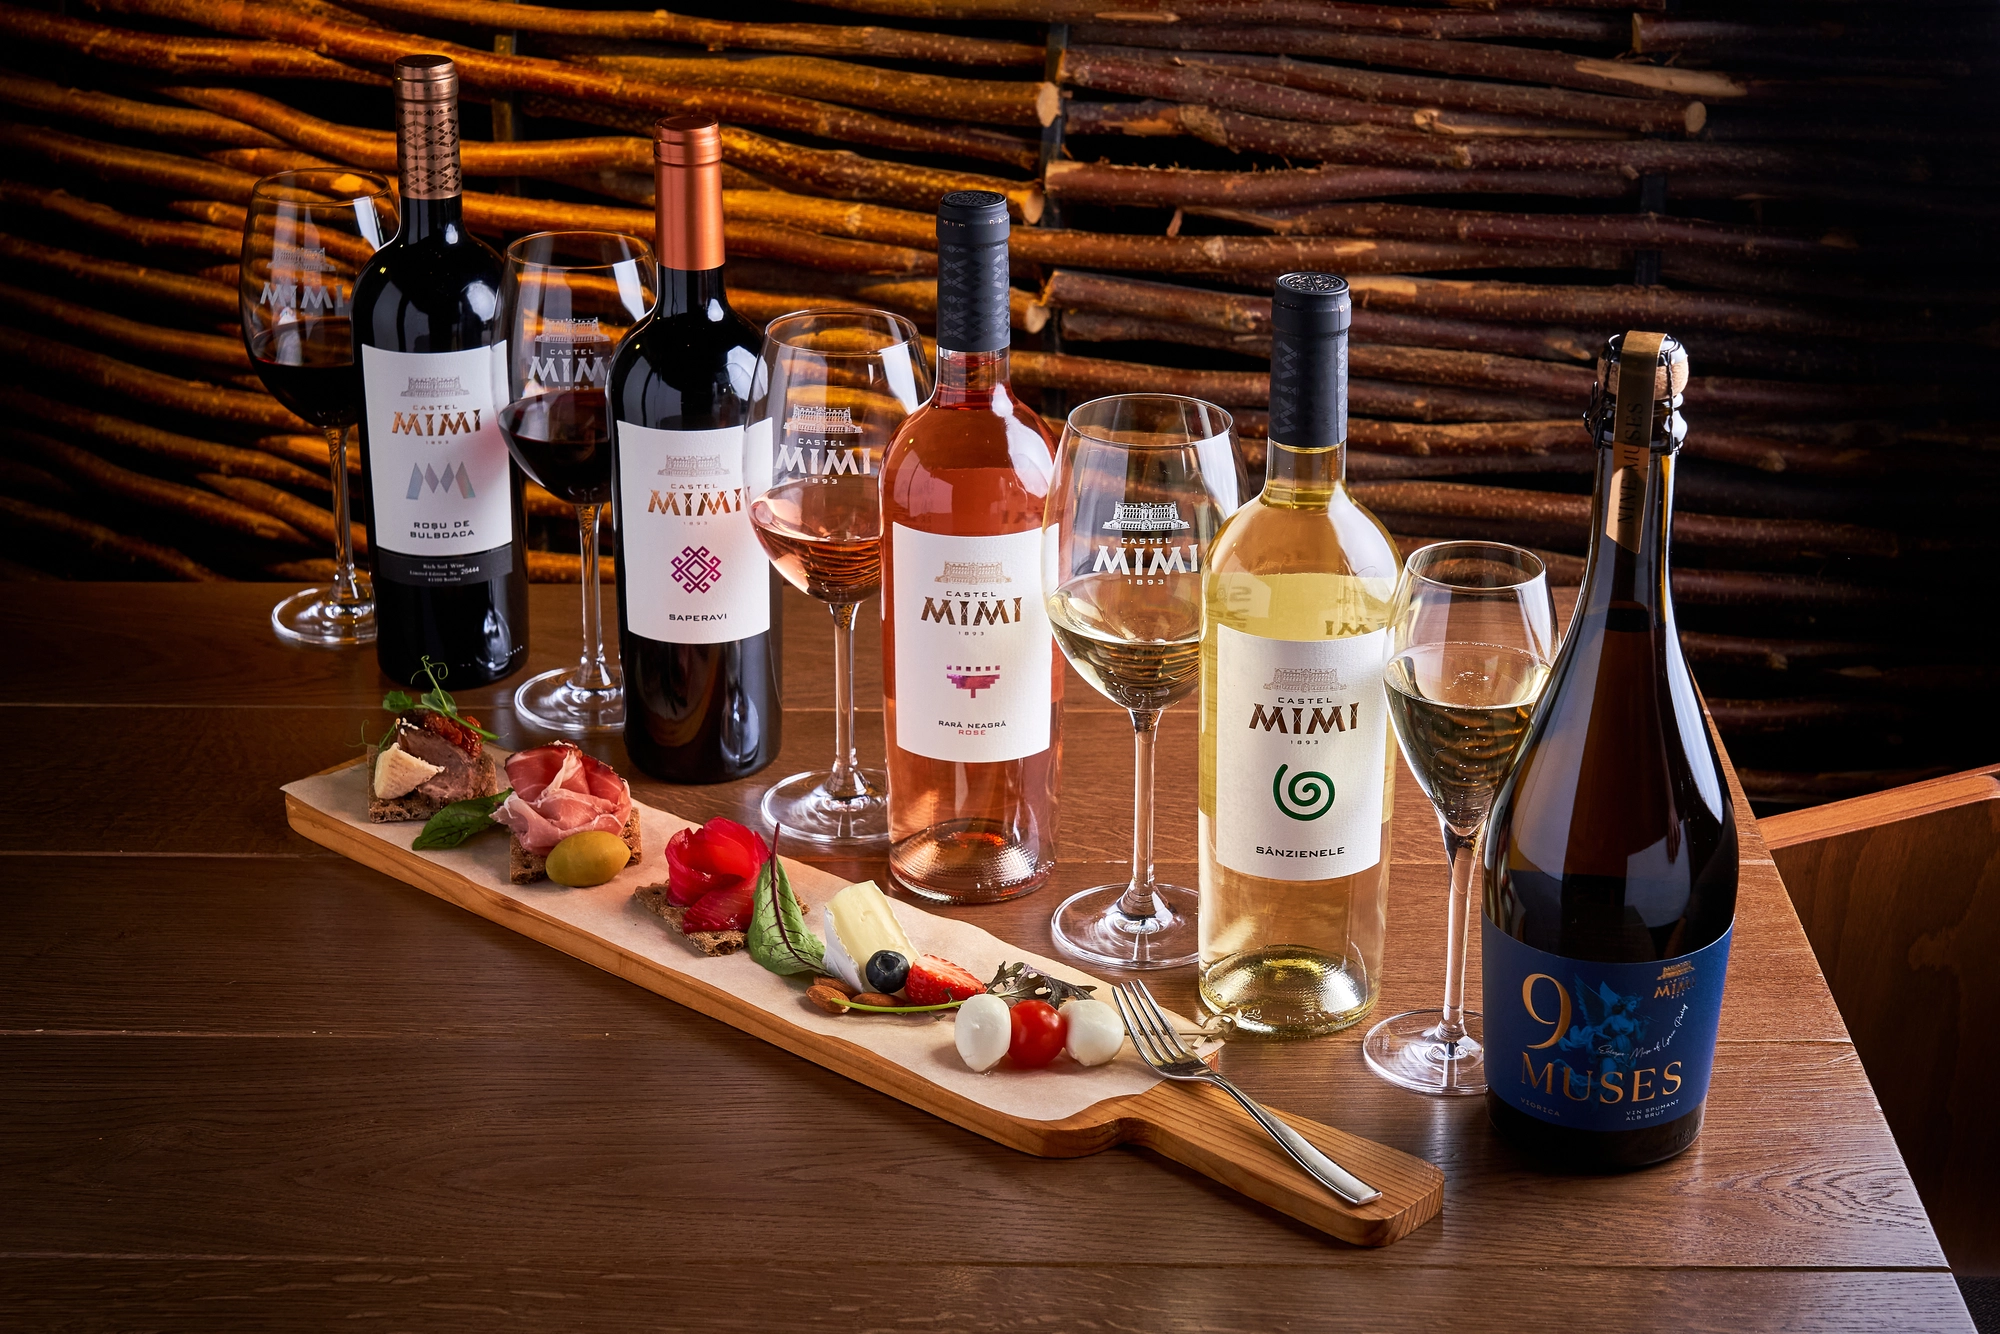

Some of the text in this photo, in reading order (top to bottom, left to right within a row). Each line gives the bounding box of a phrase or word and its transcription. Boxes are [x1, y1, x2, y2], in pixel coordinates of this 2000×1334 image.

[260, 282, 344, 309] MIMI
[549, 348, 595, 356] CASTEL
[527, 356, 607, 383] MIM
[391, 408, 481, 437] MIMI
[798, 437, 845, 447] CASTEL
[1623, 402, 1643, 472] MUSES
[774, 443, 871, 476] MIMI
[803, 477, 838, 485] 1893
[647, 487, 742, 516] MIMI
[1617, 477, 1637, 525] NINE
[410, 530, 475, 539] BULBOACA
[454, 520, 470, 528] DE
[1121, 537, 1172, 545] CASTEL
[1092, 544, 1199, 576] MIMI
[668, 613, 727, 622] SAPERAVI
[920, 596, 1023, 626] MIMI
[1277, 697, 1332, 705] CASTEL
[1248, 701, 1360, 735] MIMI
[1255, 845, 1345, 859] SÂNZIENELE
[1521, 972, 1572, 1050] 9
[1520, 1051, 1683, 1105] MUSES
[1520, 1097, 1561, 1117] VIORICA
[1644, 1109, 1665, 1119] BRUT
[1645, 1099, 1680, 1113] SPUMANT
